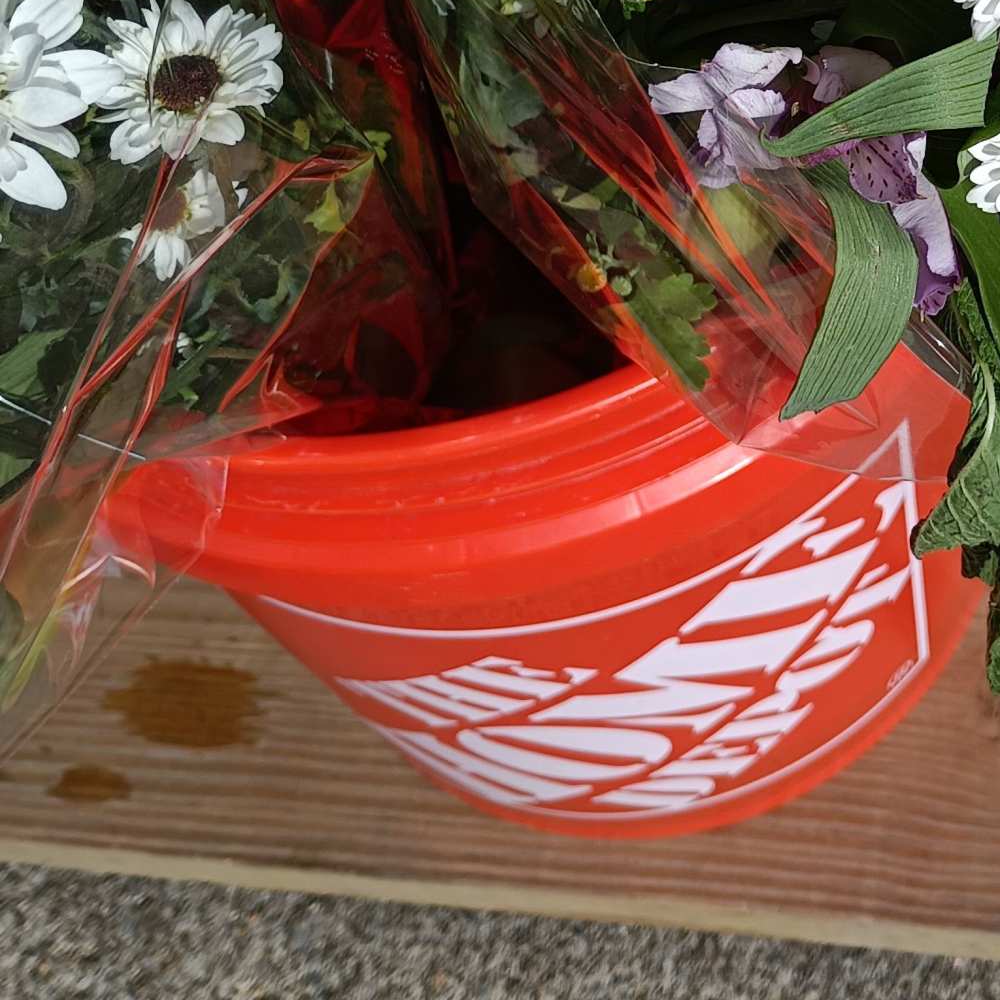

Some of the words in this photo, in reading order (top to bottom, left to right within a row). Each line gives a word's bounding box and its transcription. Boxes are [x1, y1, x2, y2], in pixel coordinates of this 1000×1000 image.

[333, 655, 599, 728] THE
[366, 480, 908, 806] HOME
[591, 563, 912, 808] DEPOT
